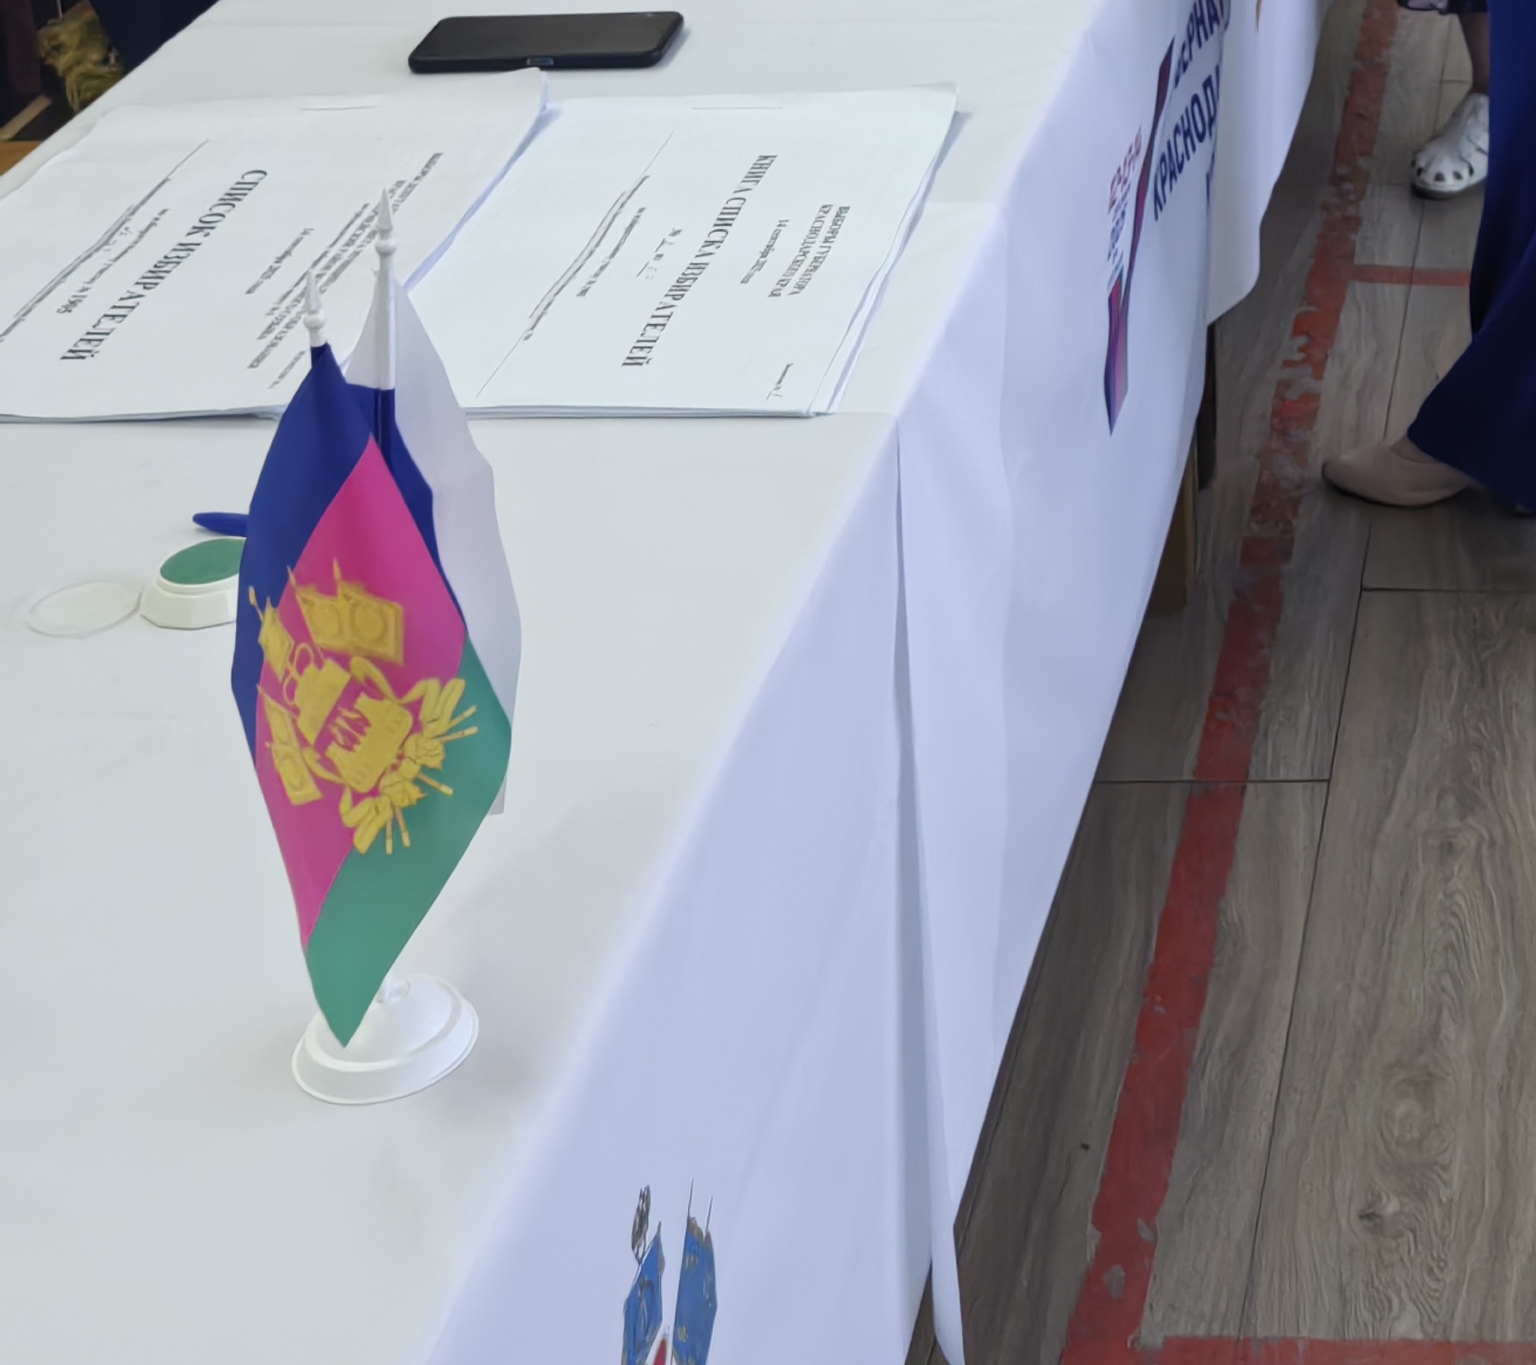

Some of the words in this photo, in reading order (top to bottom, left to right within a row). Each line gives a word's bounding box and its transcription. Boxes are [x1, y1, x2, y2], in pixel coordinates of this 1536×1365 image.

[185, 169, 268, 238] СПИСОК
[733, 154, 778, 194] КНИГА
[695, 197, 747, 258] СПИСКА
[60, 241, 203, 362] ИЗБИРАТЕЛЕЙ
[621, 261, 710, 367] ИЗБИРАТЕЛЕЙ
